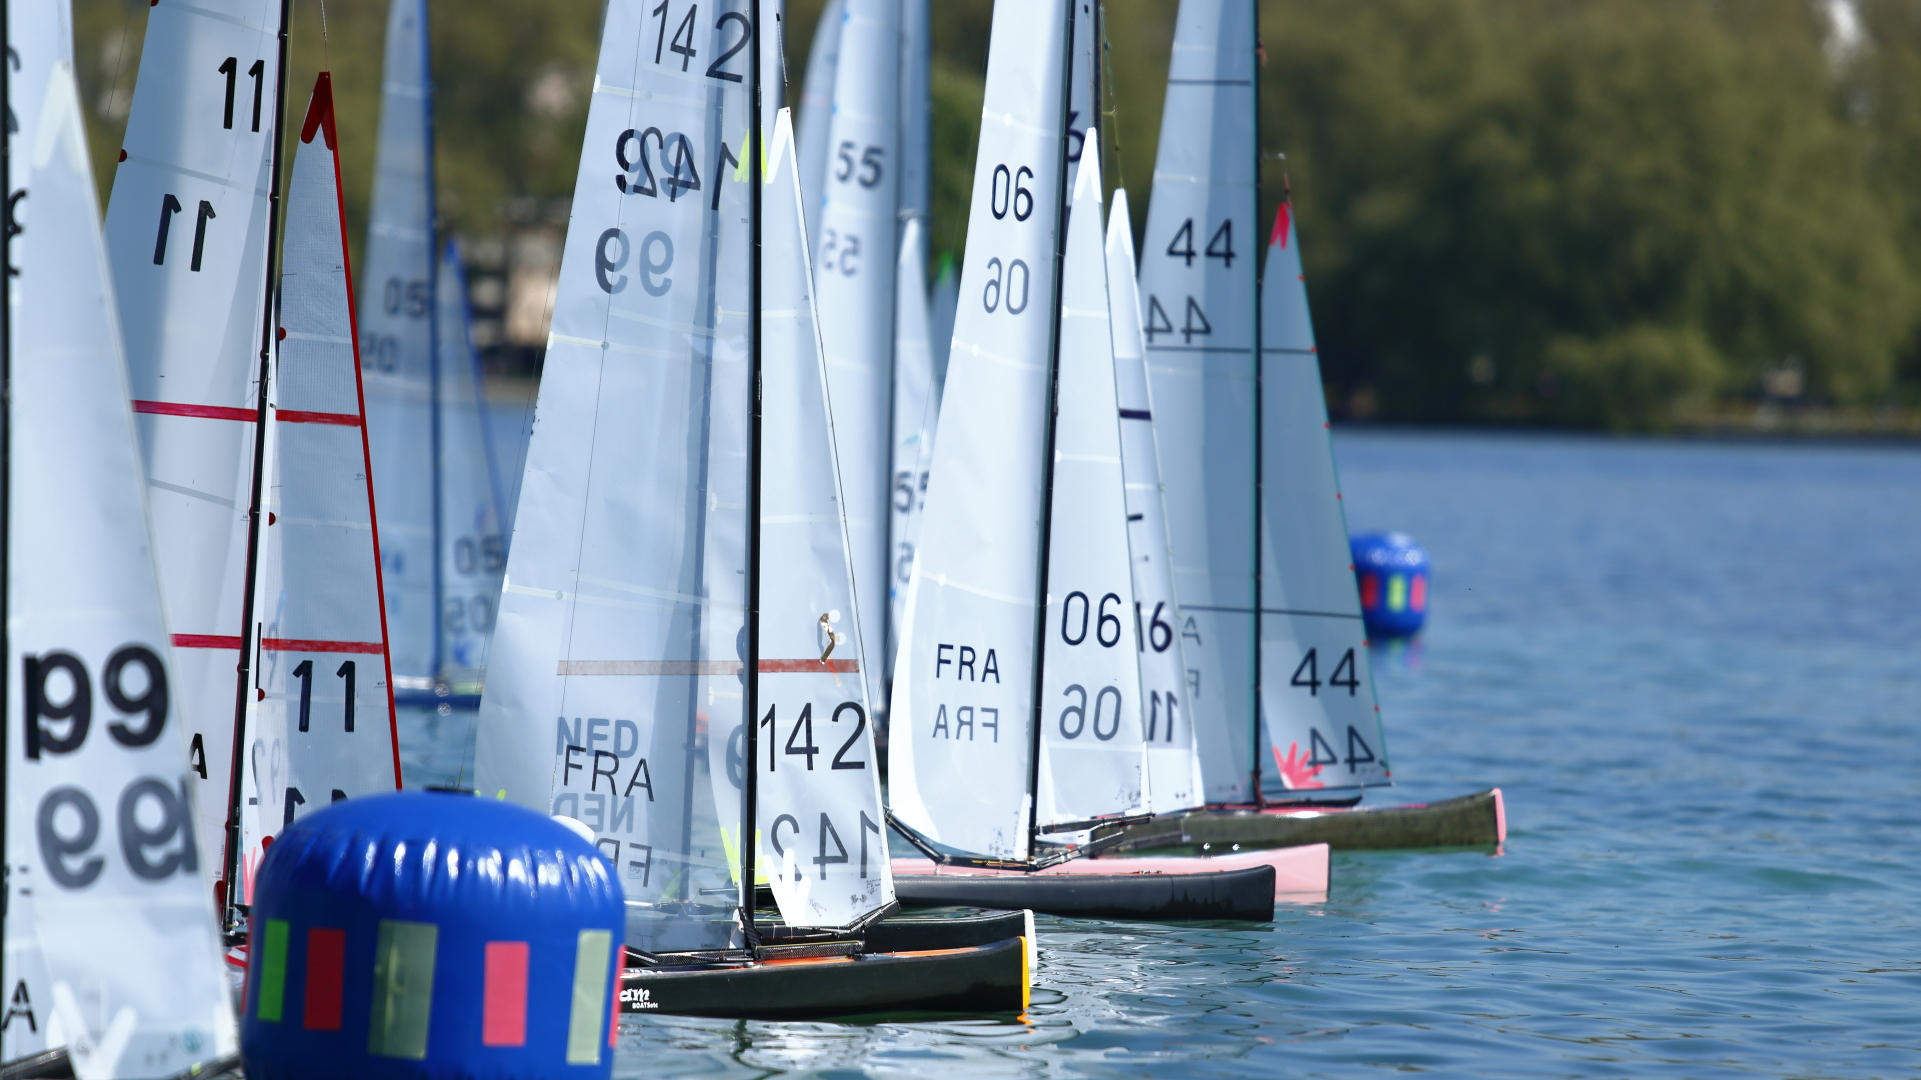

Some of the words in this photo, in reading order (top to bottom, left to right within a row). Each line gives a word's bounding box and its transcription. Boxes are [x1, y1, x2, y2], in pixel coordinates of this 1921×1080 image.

[653, 0, 751, 83] 142
[218, 57, 264, 133] 11
[836, 141, 883, 190] 55
[991, 163, 1033, 222] 06
[1166, 217, 1236, 269] 44
[1061, 591, 1121, 648] 06
[936, 643, 1000, 684] FRA
[1291, 647, 1360, 696] 44
[292, 660, 355, 732] 11
[556, 717, 639, 758] NED
[761, 701, 867, 771] 142
[564, 744, 654, 802] FRA
